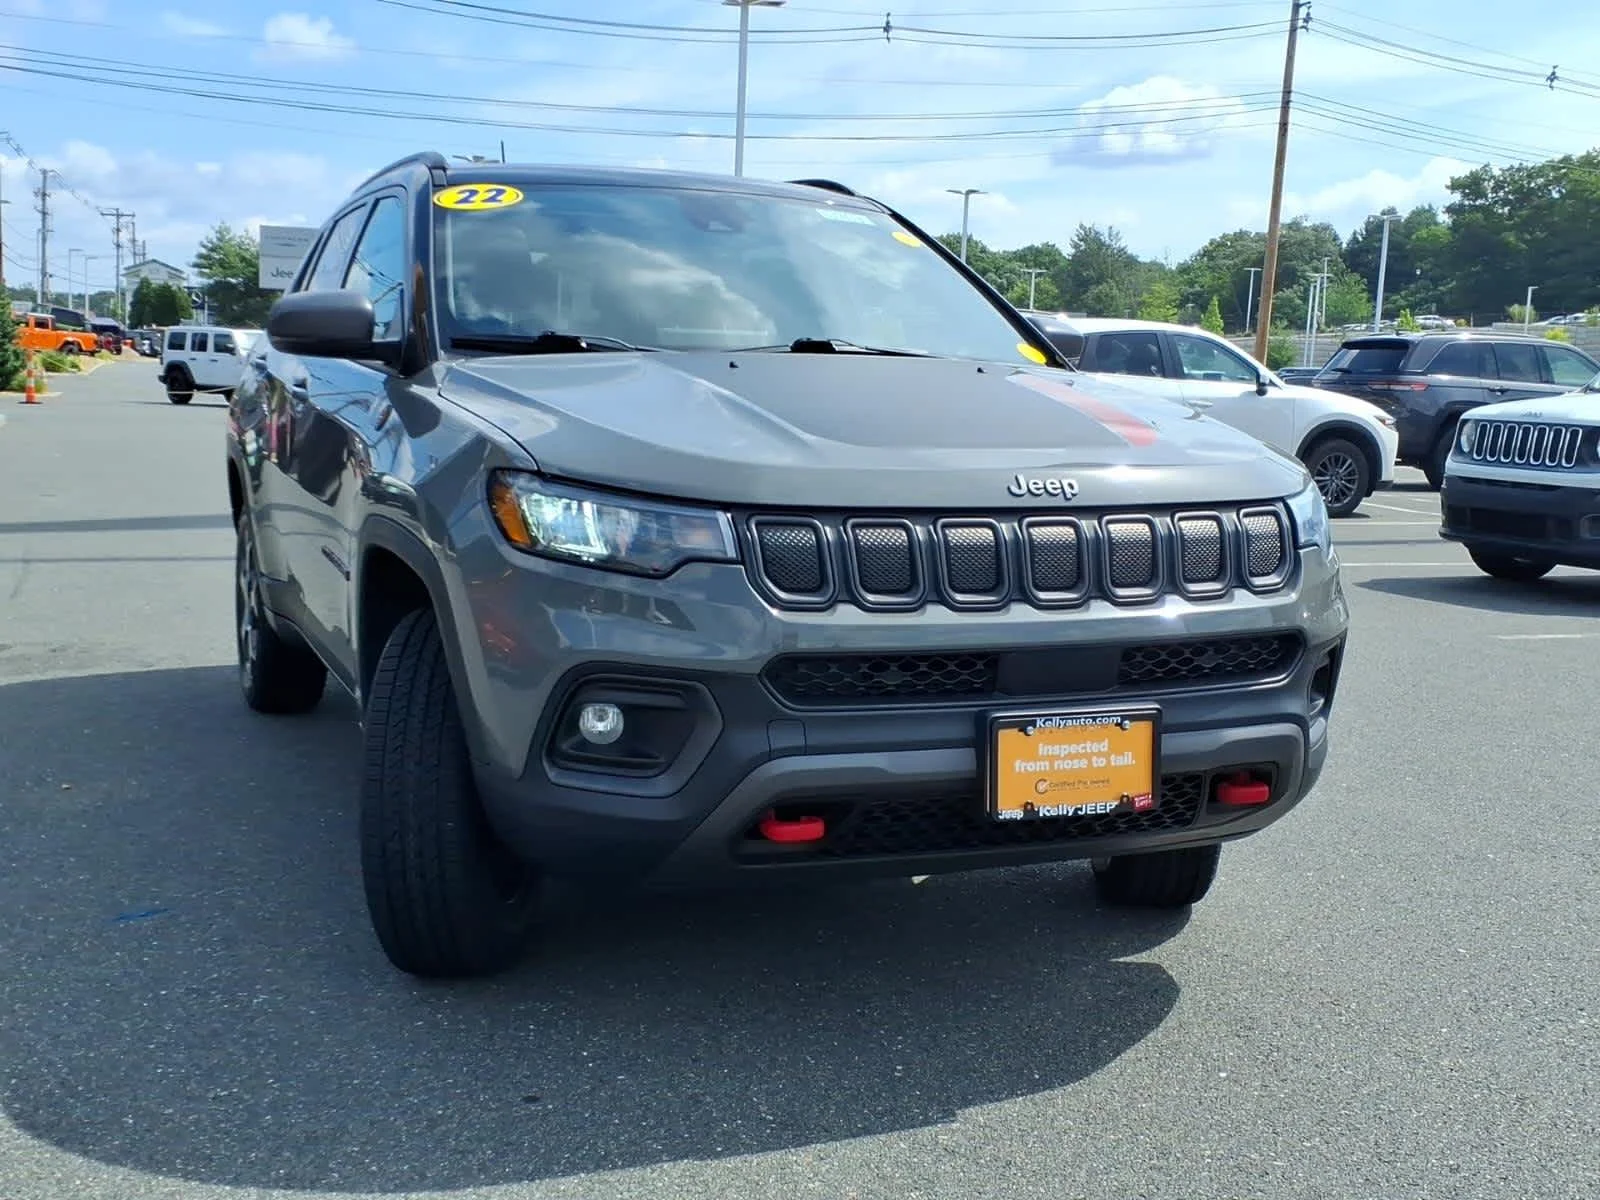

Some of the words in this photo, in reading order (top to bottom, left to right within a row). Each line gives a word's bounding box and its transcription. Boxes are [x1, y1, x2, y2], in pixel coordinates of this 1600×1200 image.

[454, 188, 507, 204] 22
[270, 267, 296, 279] Jee
[1007, 474, 1079, 500] Jeep
[1036, 715, 1121, 729] Kellyauto.com
[1039, 738, 1109, 757] Inspected
[1015, 759, 1050, 773] from
[1054, 758, 1089, 770] nose
[1091, 756, 1107, 768] to
[1110, 751, 1136, 766] tail.
[998, 808, 1024, 820] Jeep
[1039, 803, 1076, 817] Kelly
[1077, 800, 1119, 815] JEEP
